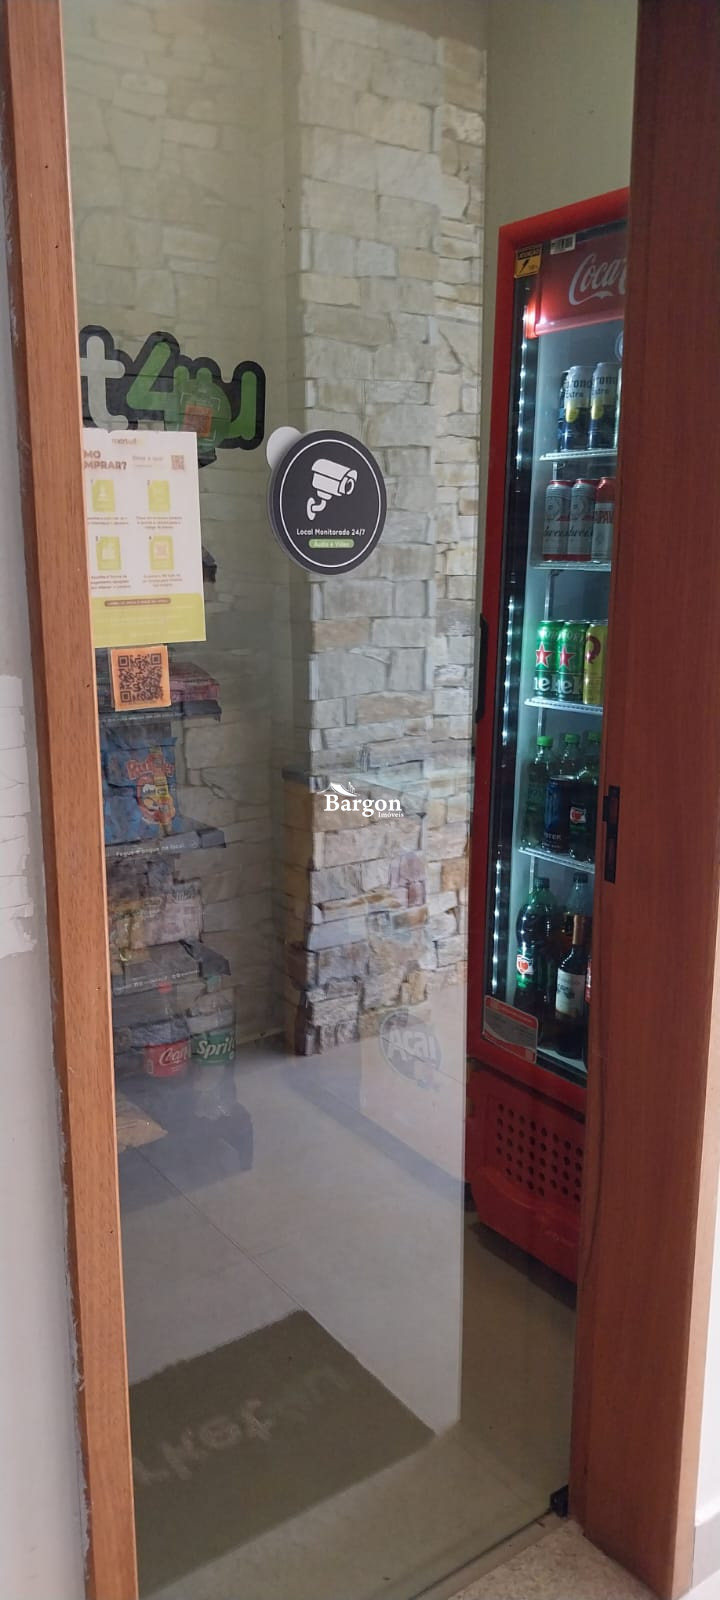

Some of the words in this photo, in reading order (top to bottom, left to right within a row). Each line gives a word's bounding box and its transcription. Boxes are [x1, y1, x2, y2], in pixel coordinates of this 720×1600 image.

[296, 528, 314, 536] Local
[315, 528, 350, 536] Monitorado
[351, 528, 366, 537] 24/7
